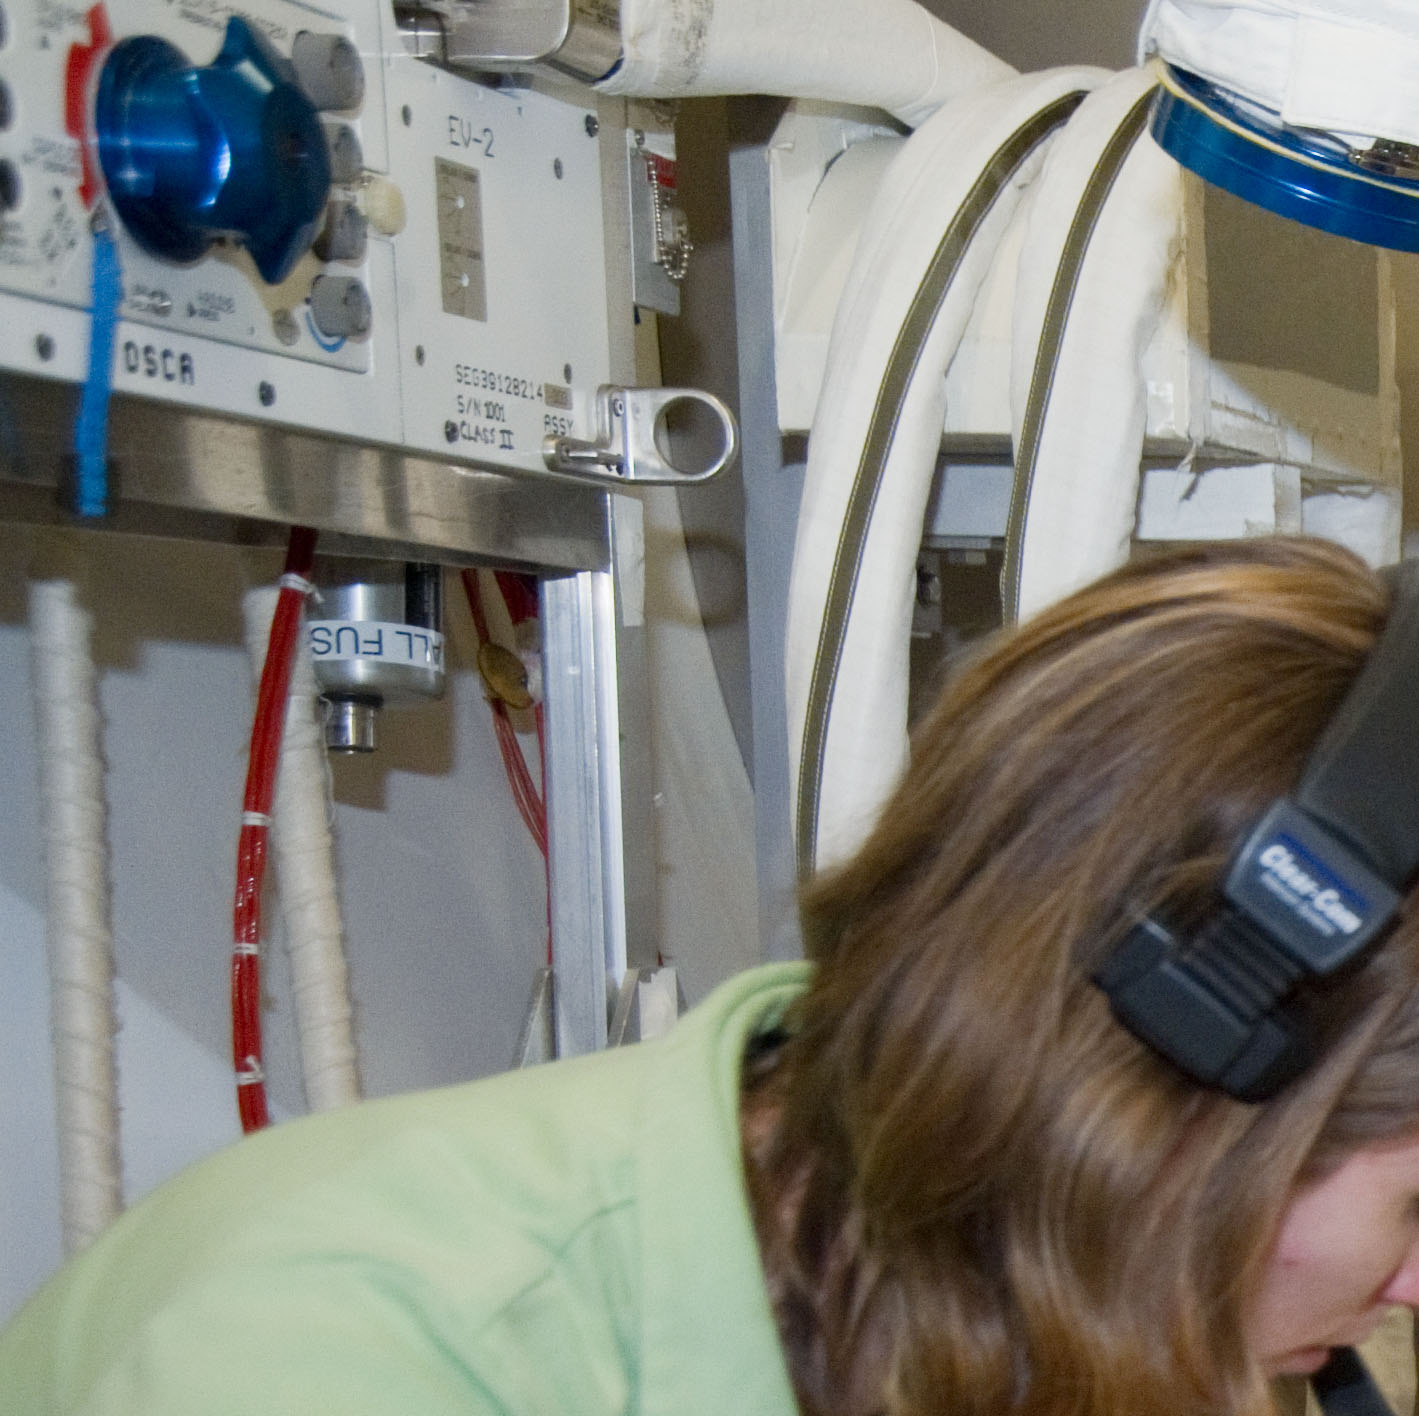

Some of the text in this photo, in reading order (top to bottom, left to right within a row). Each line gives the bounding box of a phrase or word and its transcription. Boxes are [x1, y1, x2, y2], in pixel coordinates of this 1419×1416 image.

[449, 115, 496, 158] EV-2
[457, 394, 482, 418] S/N
[459, 420, 496, 445] CLASS
[544, 413, 575, 437] ASSY
